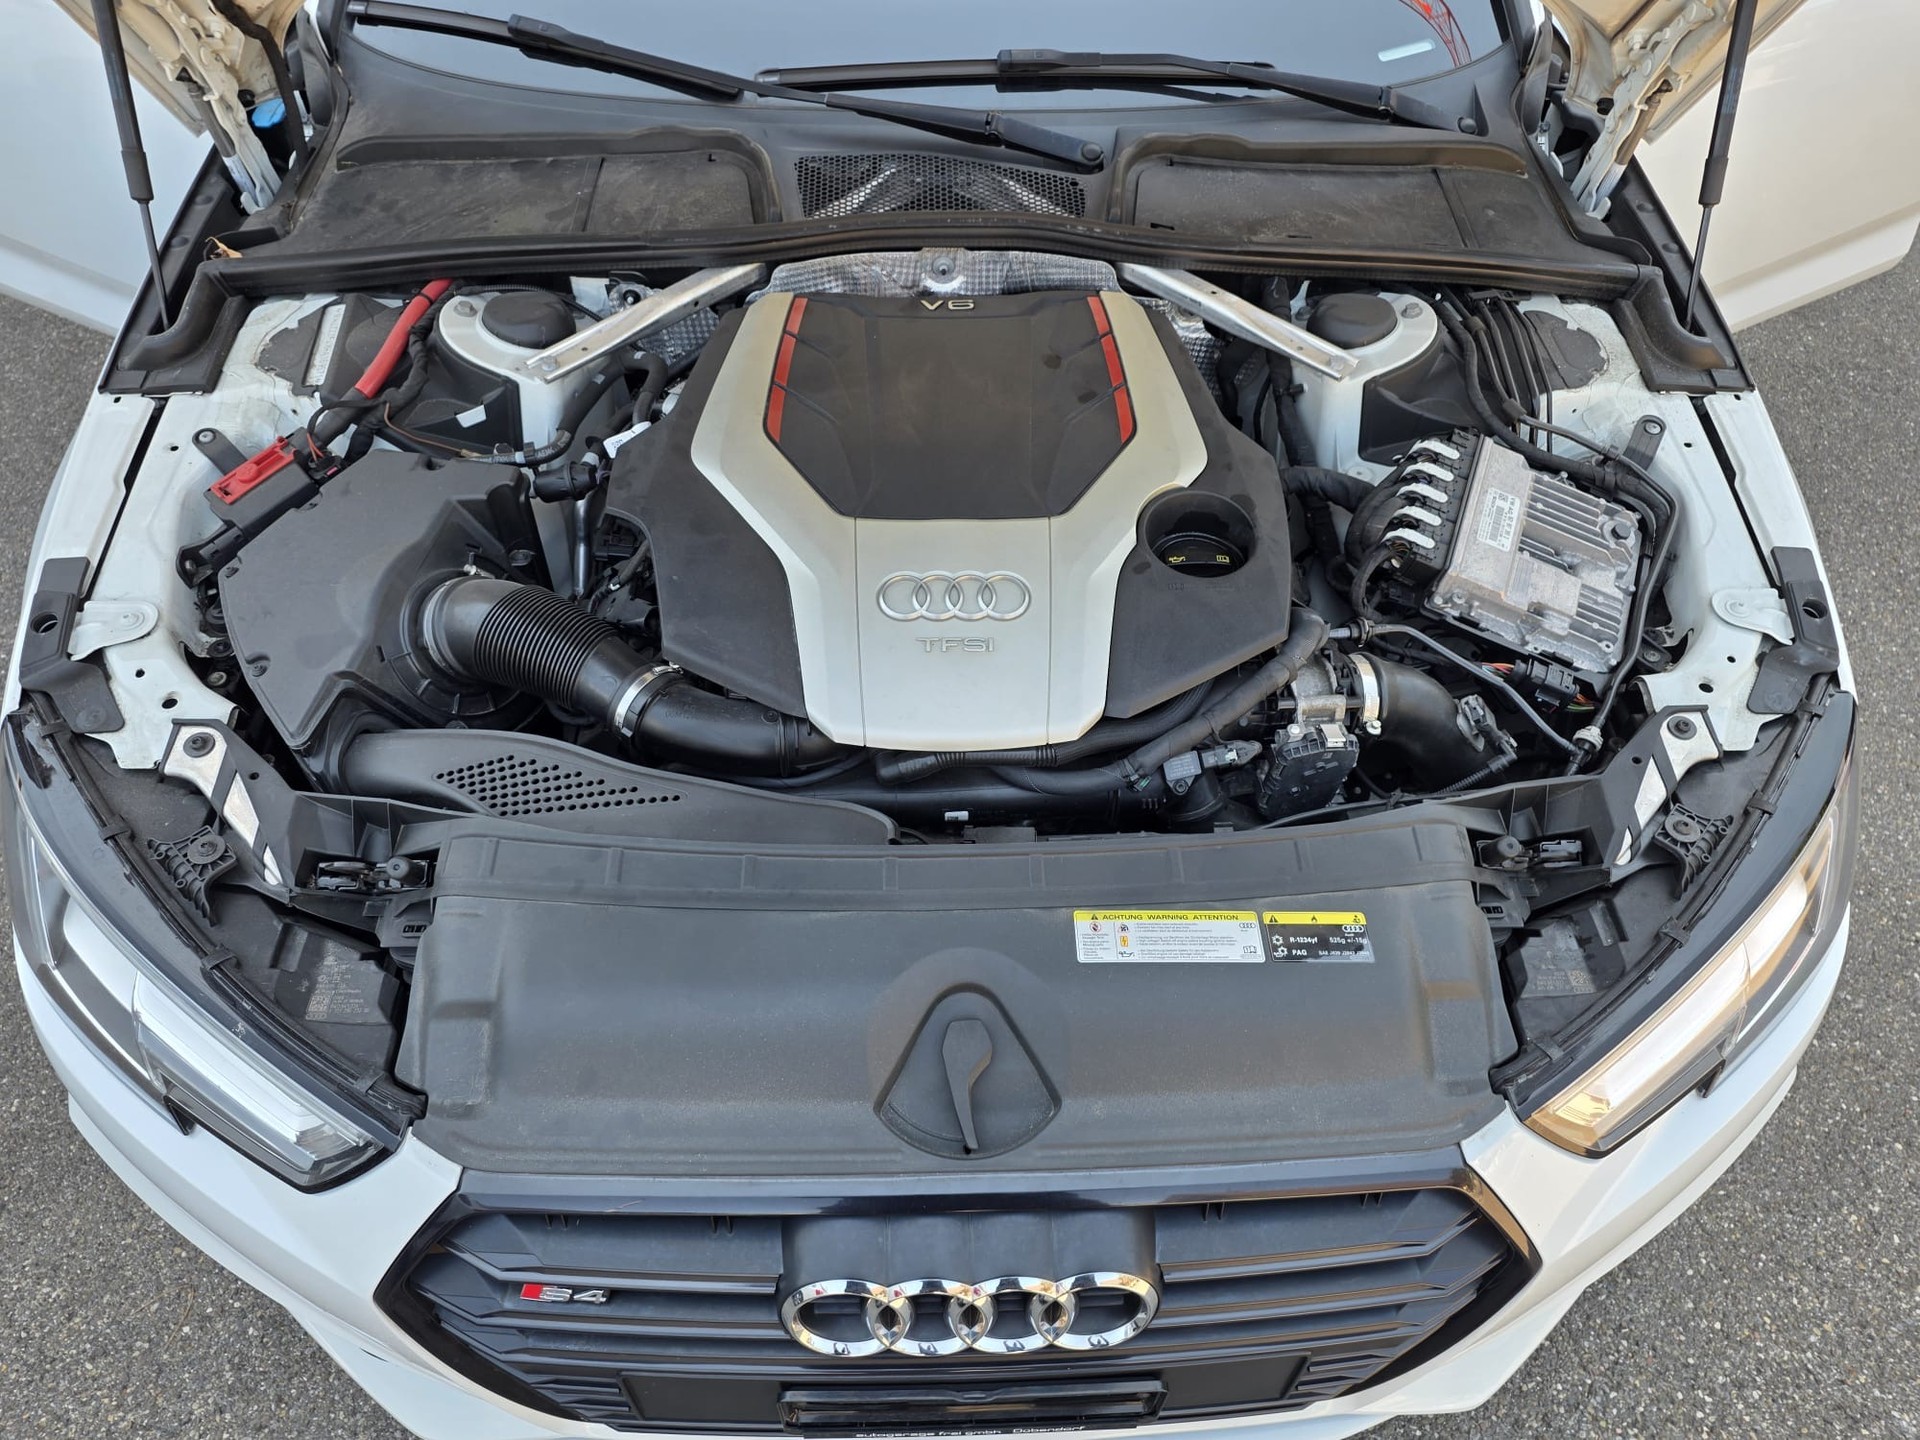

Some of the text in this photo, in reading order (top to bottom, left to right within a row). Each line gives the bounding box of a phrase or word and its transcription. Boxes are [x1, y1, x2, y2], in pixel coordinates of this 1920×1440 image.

[920, 299, 975, 310] V6
[914, 637, 994, 653] TFSI
[539, 1285, 607, 1304] S4
